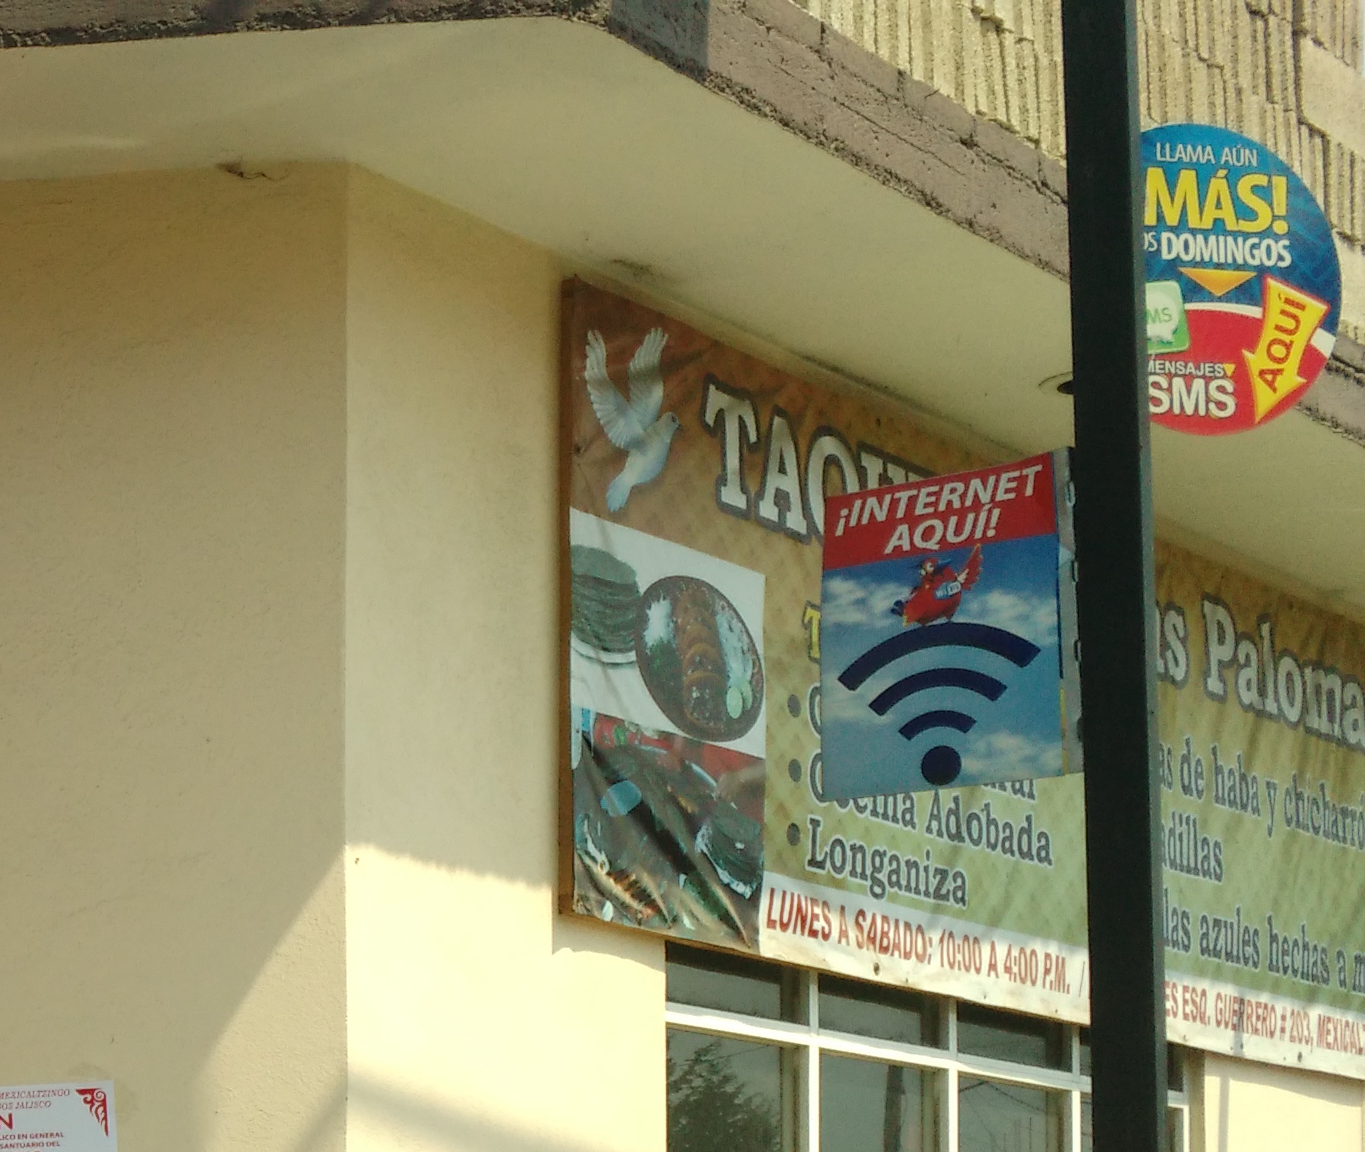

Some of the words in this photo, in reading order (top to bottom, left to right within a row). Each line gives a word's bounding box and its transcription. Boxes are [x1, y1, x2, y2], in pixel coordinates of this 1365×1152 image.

[1157, 142, 1215, 164] LLAMA
[1221, 144, 1257, 166] AÚN
[1144, 167, 1289, 235] MÁS!
[1161, 233, 1291, 268] DOMINGOS
[1147, 307, 1172, 323] MS
[1259, 292, 1307, 394] AQUÍ
[1149, 376, 1237, 418] SMS
[835, 466, 1043, 537] ¡INTERNET
[883, 502, 1001, 554] AQUÍ!
[1180, 737, 1204, 801] de
[1212, 744, 1261, 818] haba
[1265, 779, 1277, 838] y
[807, 818, 968, 906] Longaniza
[927, 788, 1052, 866] Adobada
[1162, 811, 1224, 882] dillas
[767, 888, 832, 942] LUNES
[838, 906, 849, 945] A
[855, 908, 933, 965] SABADO:
[939, 929, 982, 975] 10:00
[987, 941, 999, 978] A
[1003, 944, 1038, 986] 4:00
[1043, 953, 1070, 994] P.M.
[1163, 887, 1191, 953] las
[1199, 906, 1260, 970] azules
[1267, 914, 1330, 986] hechas
[1336, 949, 1347, 990] a
[1182, 985, 1211, 1026] ESQ.
[1215, 992, 1277, 1039] GUERRERO
[1279, 1006, 1287, 1041] #
[1289, 1009, 1313, 1052] 203,
